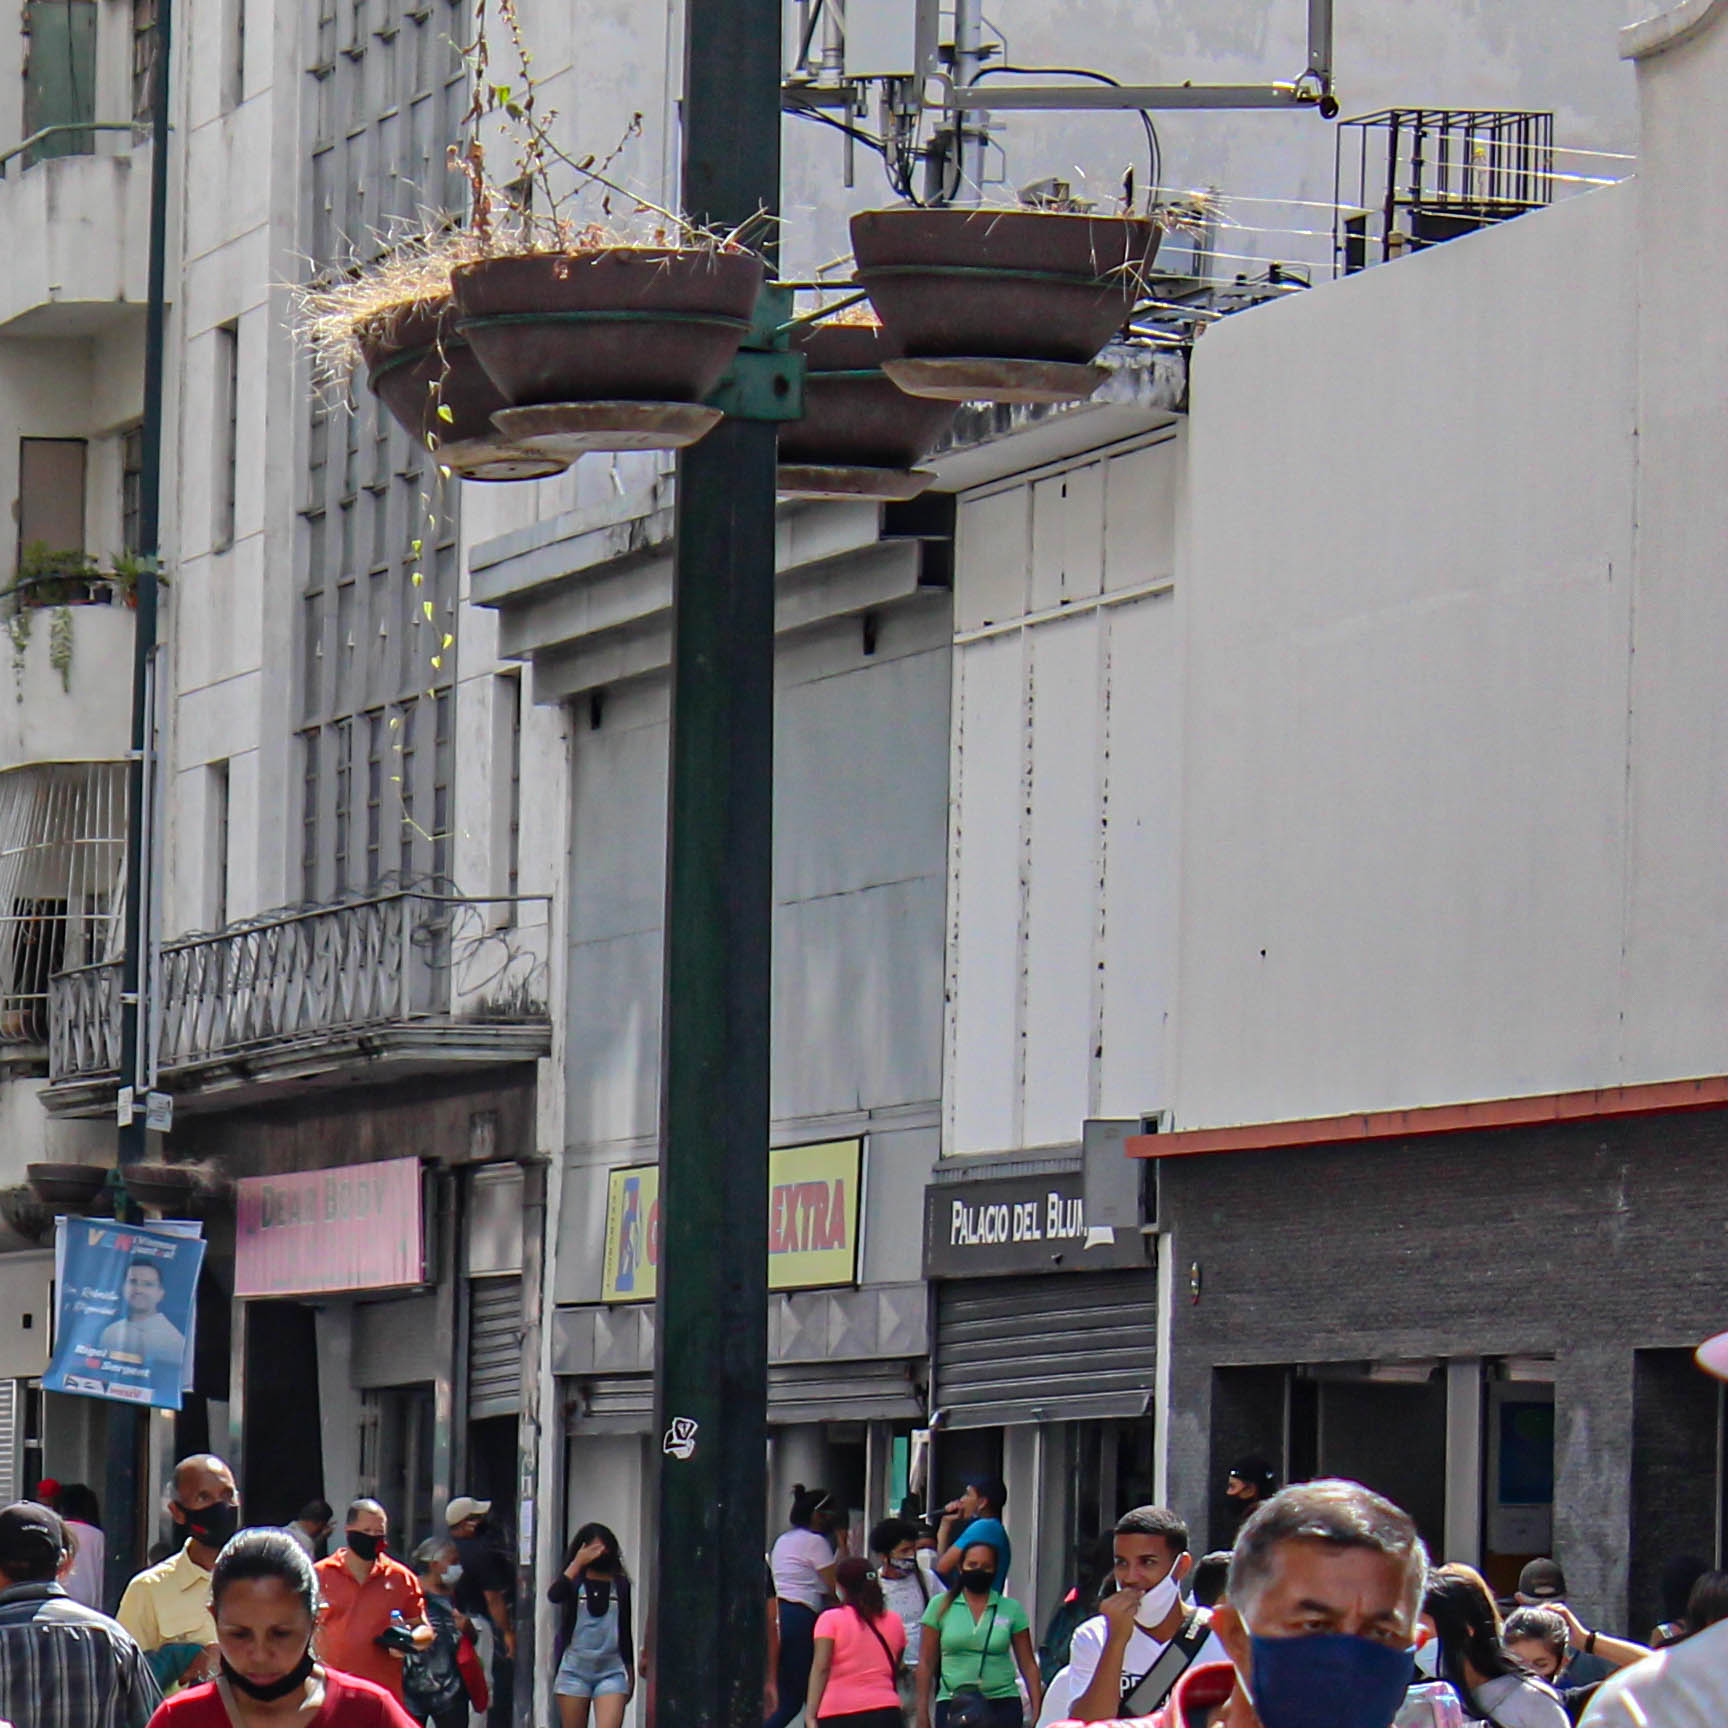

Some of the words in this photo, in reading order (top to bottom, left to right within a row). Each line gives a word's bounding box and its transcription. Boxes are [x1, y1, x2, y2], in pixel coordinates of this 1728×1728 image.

[769, 1178, 846, 1255] EXTRA
[951, 1201, 1010, 1246] PALACIO
[1012, 1202, 1042, 1242] DEL
